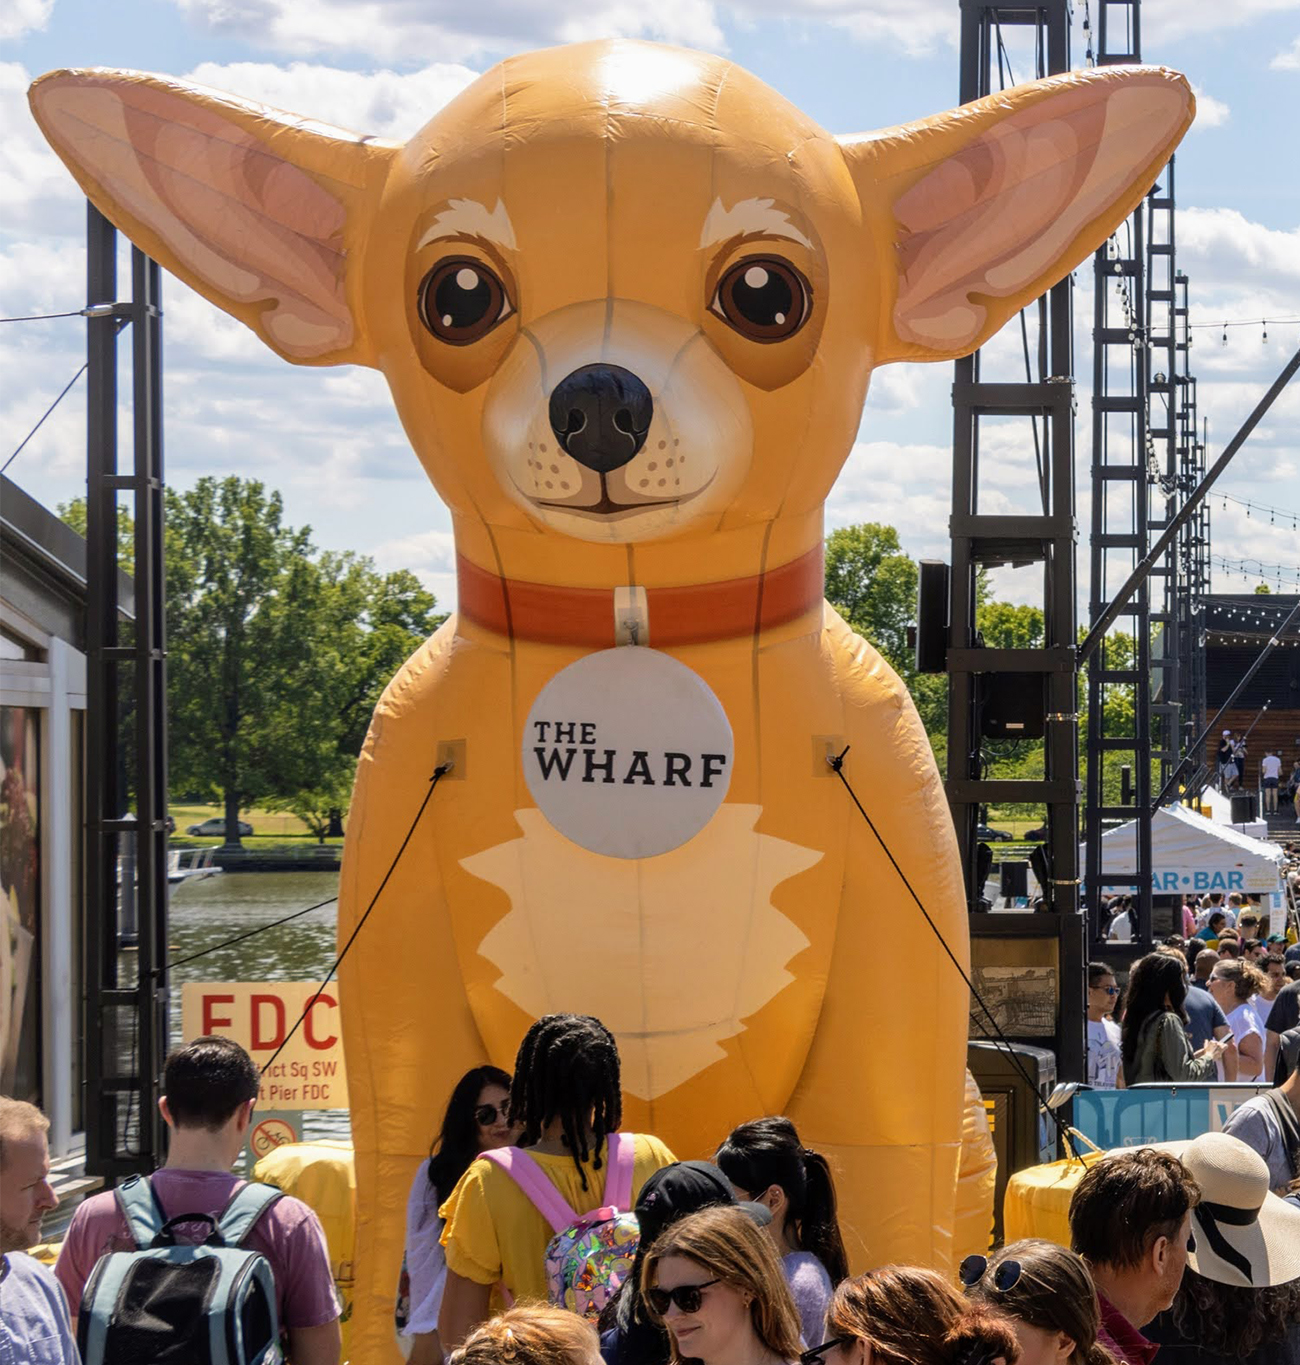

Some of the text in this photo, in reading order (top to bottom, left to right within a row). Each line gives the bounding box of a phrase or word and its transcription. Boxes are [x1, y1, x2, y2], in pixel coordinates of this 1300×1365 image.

[534, 721, 596, 744] THE
[533, 747, 726, 788] WHARF
[291, 1062, 308, 1081] Sq
[312, 1061, 337, 1077] SW
[270, 1085, 298, 1100] Pier
[303, 1084, 330, 1100] FDC
